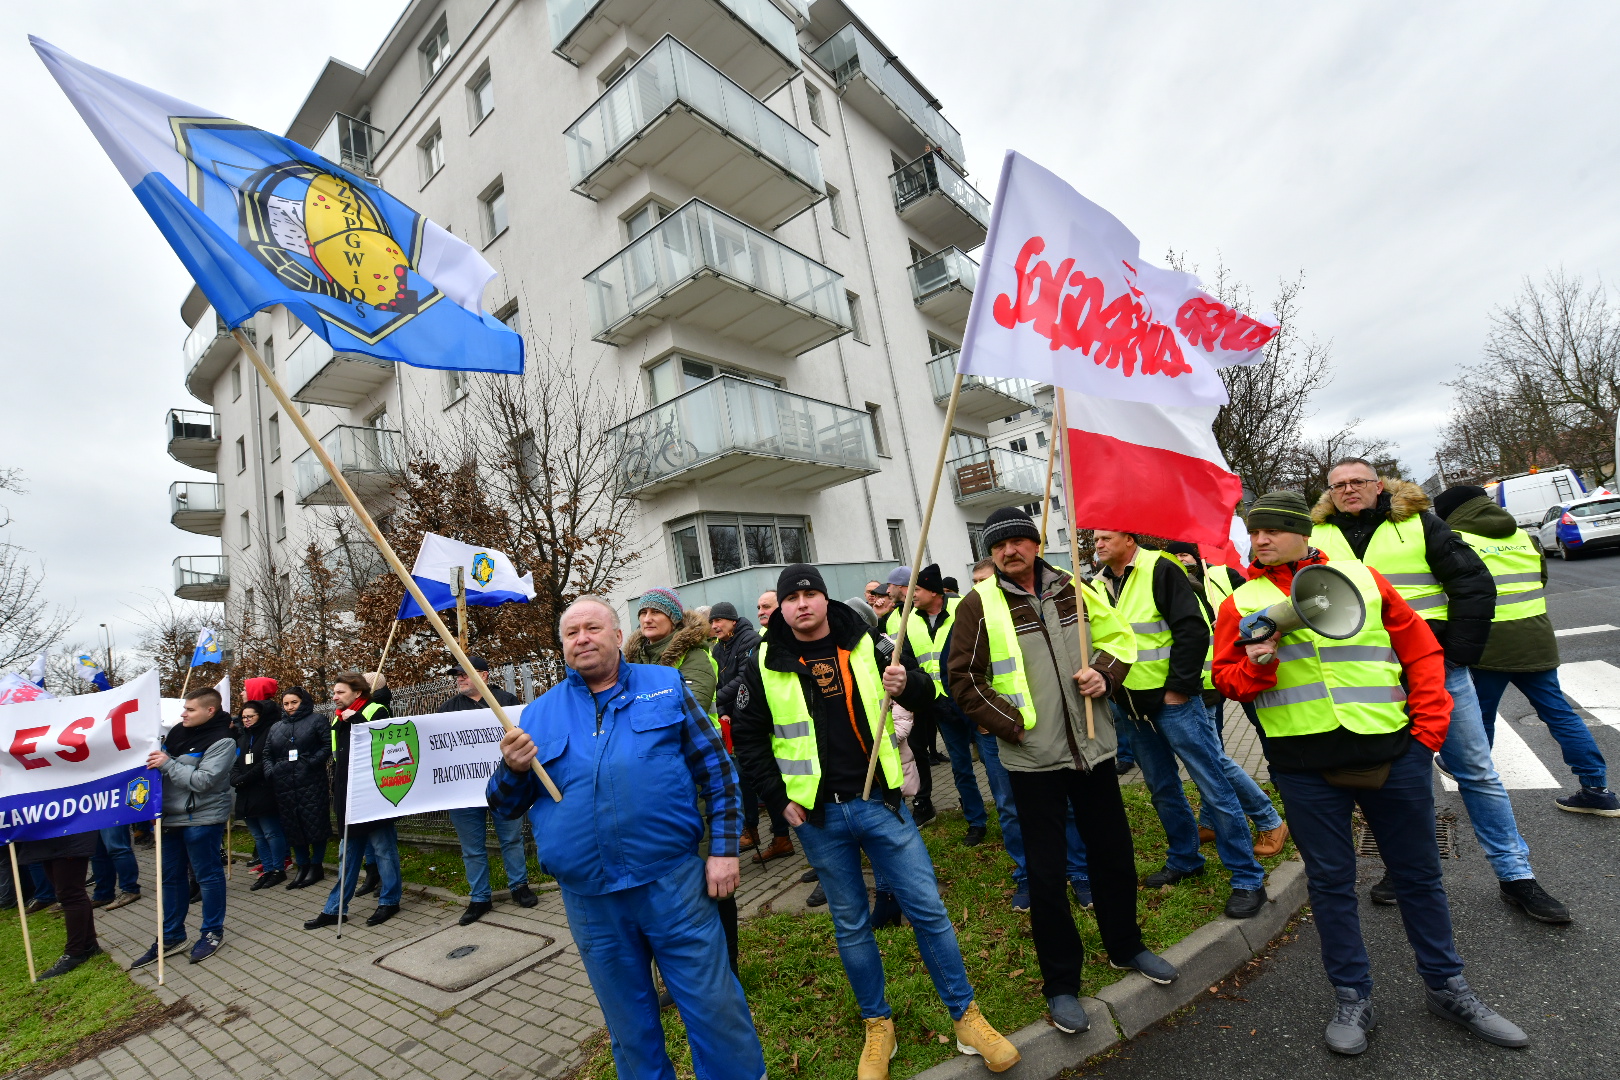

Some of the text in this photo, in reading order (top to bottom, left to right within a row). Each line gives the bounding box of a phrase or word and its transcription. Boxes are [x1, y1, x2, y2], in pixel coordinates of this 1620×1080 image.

[635, 688, 674, 701] AQUANET
[8, 698, 139, 770] EST
[379, 727, 410, 741] NSZZ
[428, 731, 459, 752] SEKCJA
[432, 757, 493, 784] PRACOWNIKÓW
[0, 788, 121, 829] ZAWODOWE
